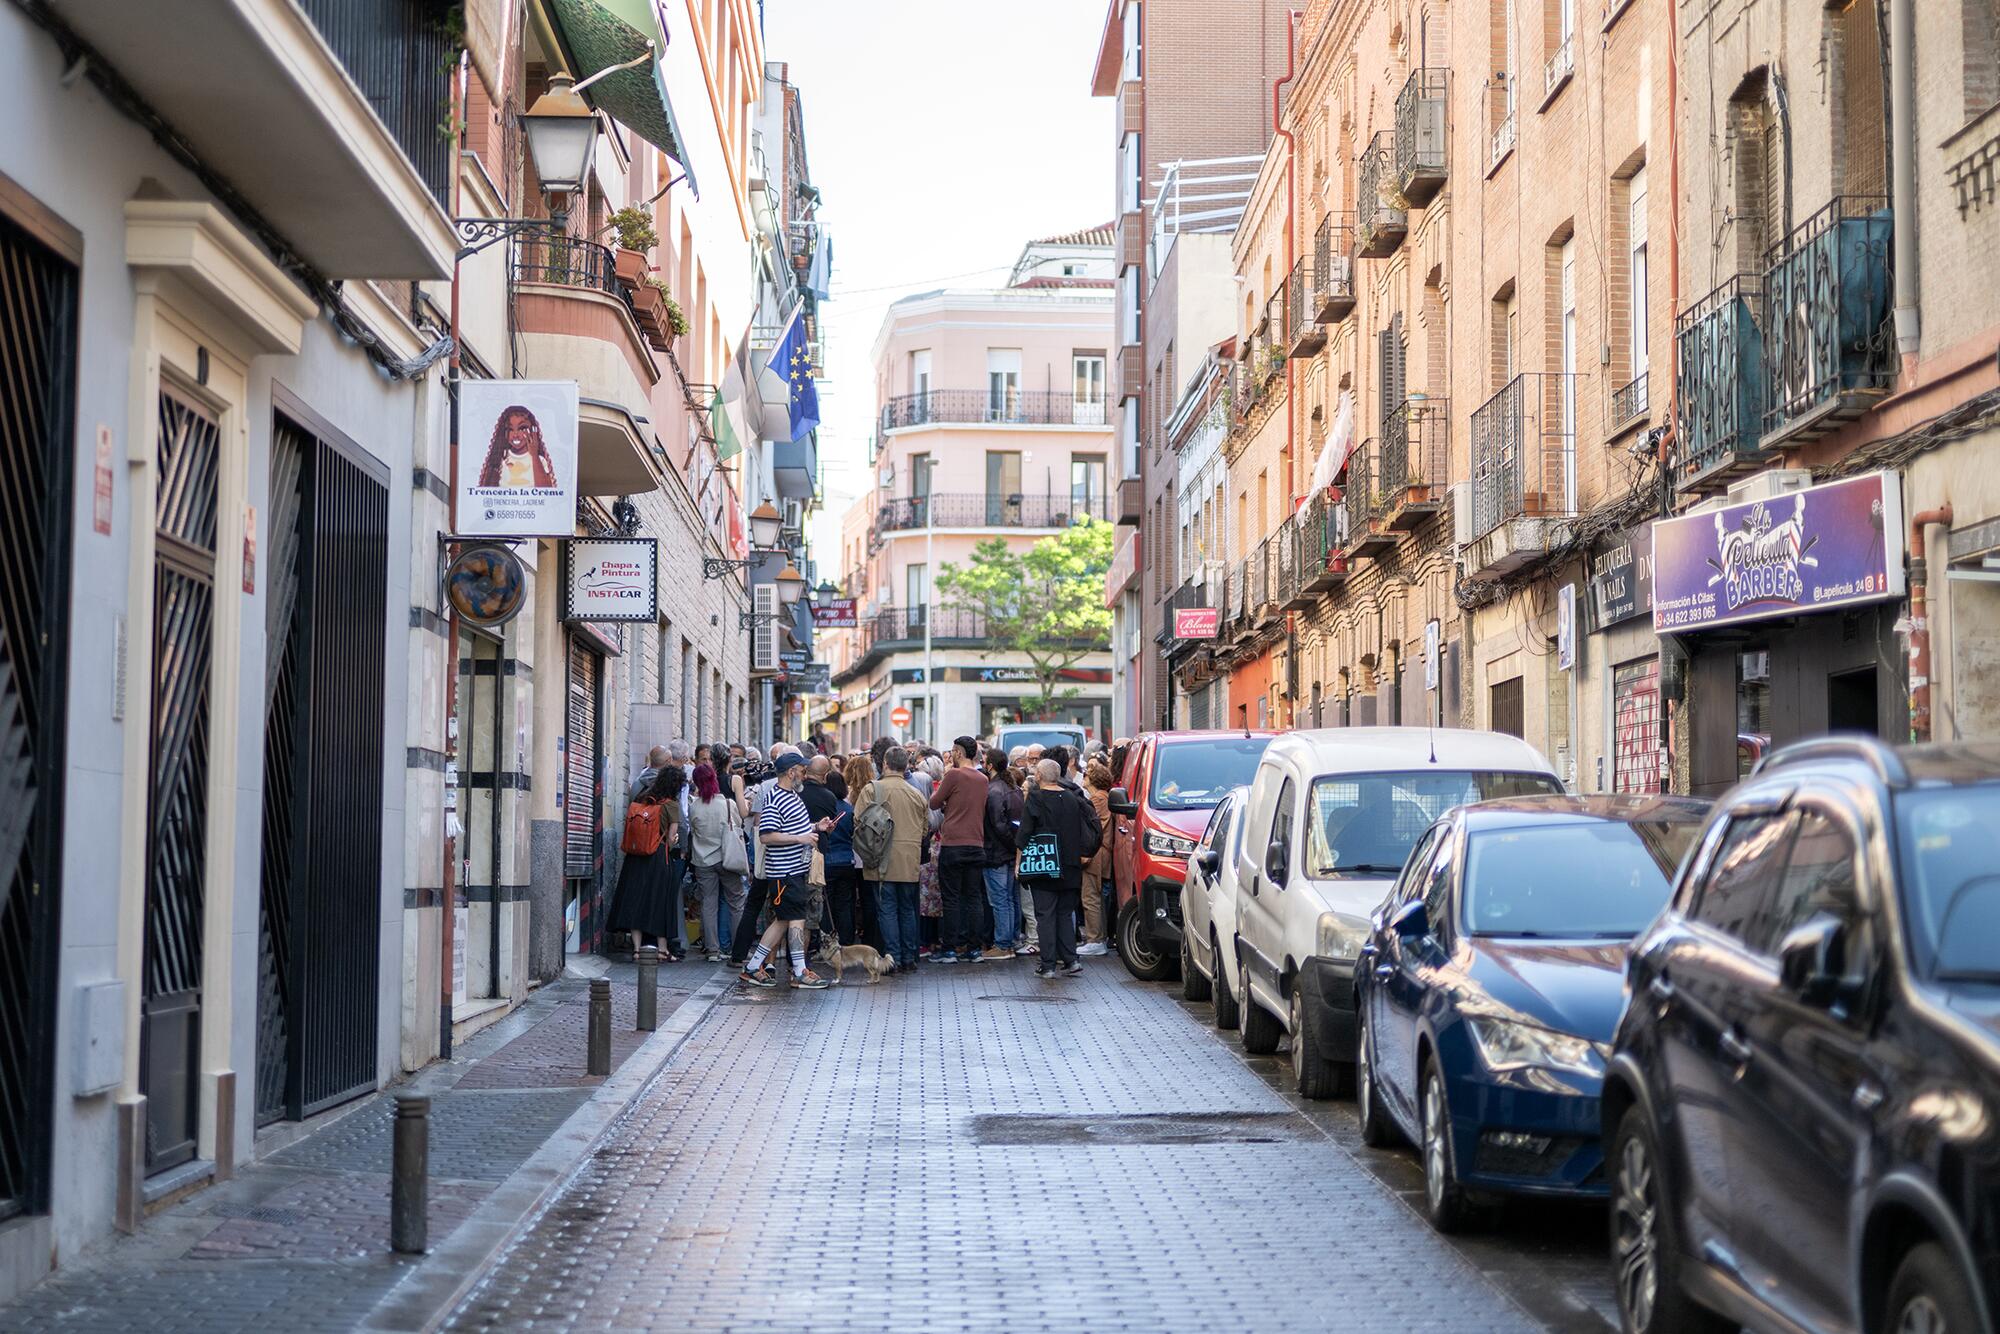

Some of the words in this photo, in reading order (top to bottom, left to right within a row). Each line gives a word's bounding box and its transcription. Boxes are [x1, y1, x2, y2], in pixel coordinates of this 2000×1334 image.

[520, 488, 529, 496] la
[497, 511, 536, 519] 658976555
[588, 590, 641, 598] INSTACAR
[1608, 576, 1626, 602] NAILS
[1726, 566, 1797, 610] BARBER
[1692, 593, 1697, 605] &
[1664, 612, 1674, 625] +34
[1675, 610, 1688, 624] 622
[1689, 607, 1702, 621] 393
[1703, 605, 1717, 619] 065
[1020, 855, 1060, 873] dida.
